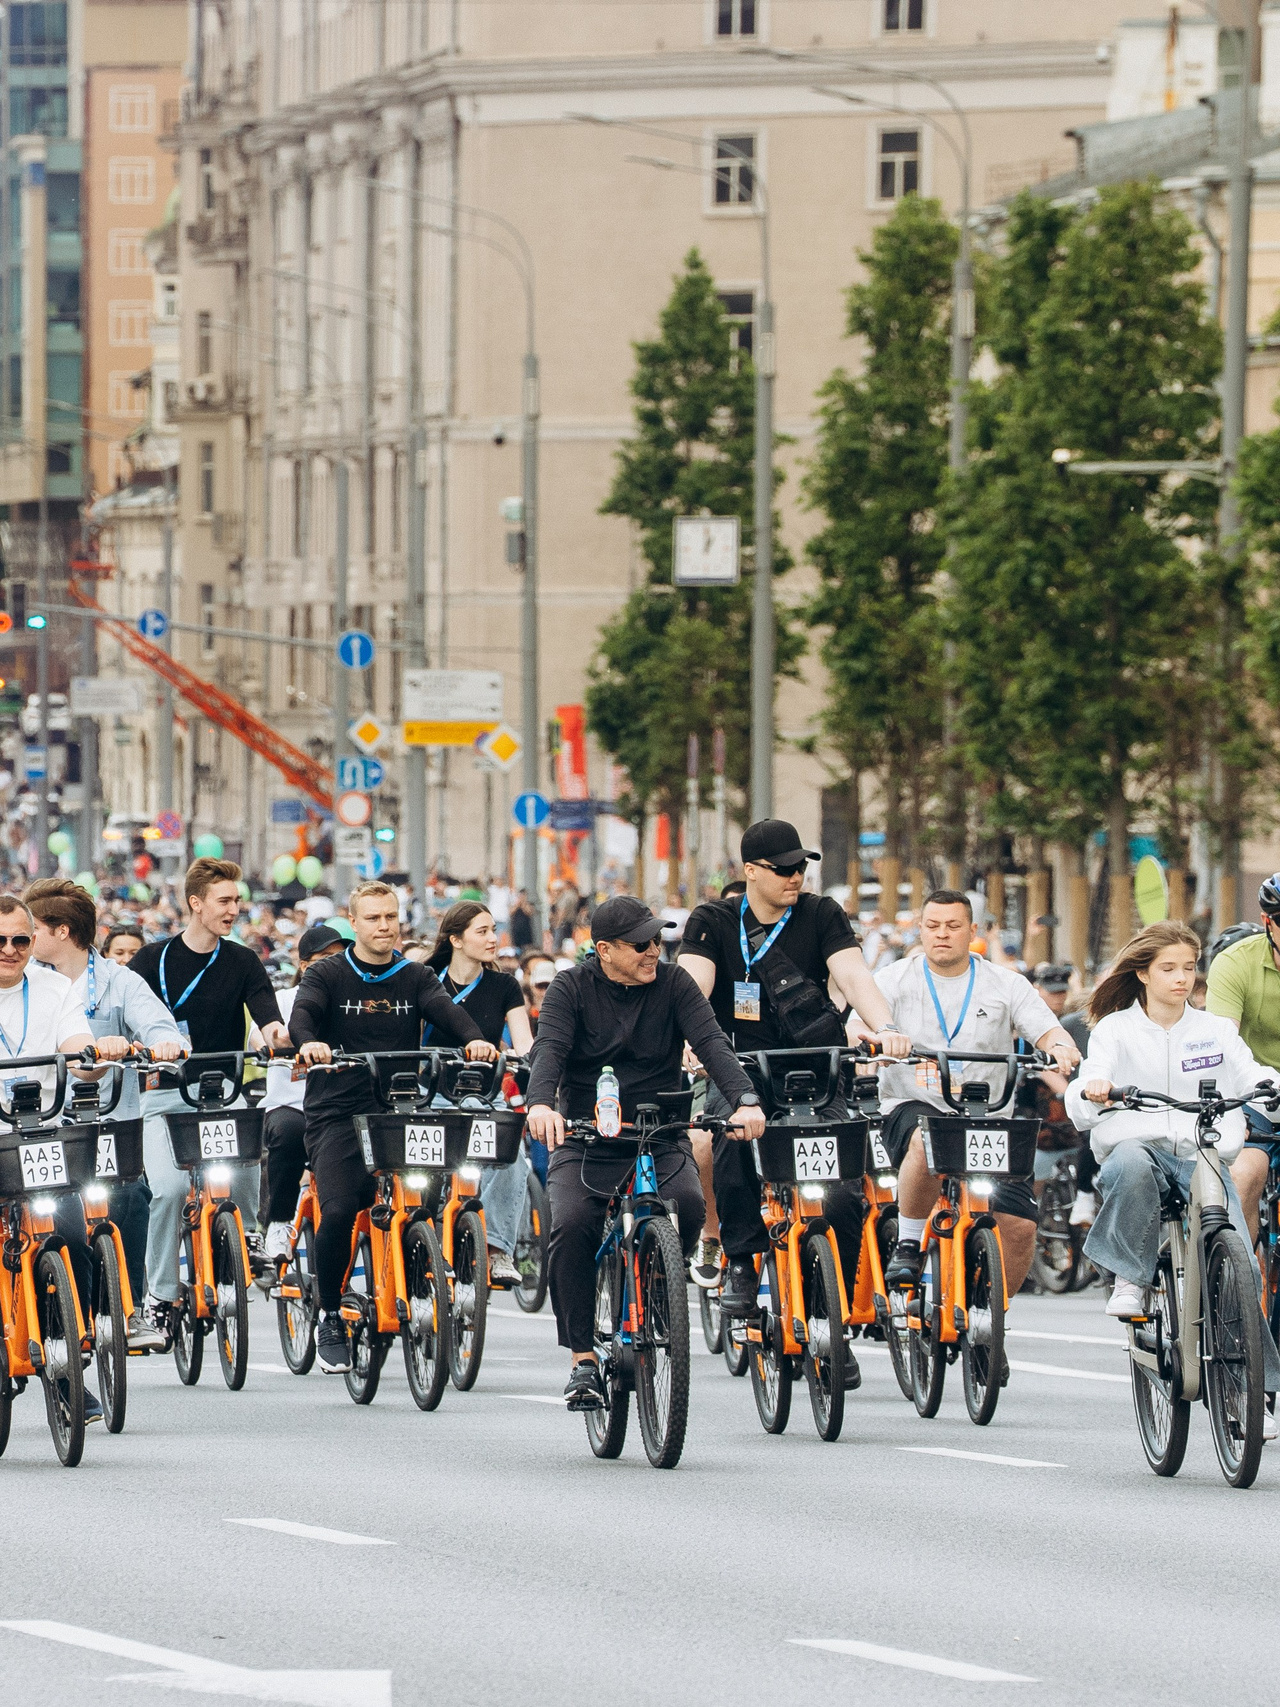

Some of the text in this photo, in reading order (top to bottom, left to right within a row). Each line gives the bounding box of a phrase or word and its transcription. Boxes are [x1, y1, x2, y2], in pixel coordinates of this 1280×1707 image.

[202, 1123, 234, 1139] АА0
[407, 1128, 443, 1144] АА0
[472, 1124, 493, 1138] А1
[203, 1139, 236, 1155] 65Т
[472, 1140, 494, 1154] 8Т
[796, 1140, 835, 1158] АА9
[968, 1134, 1005, 1149] АА4
[23, 1145, 61, 1165] АА5
[408, 1146, 443, 1162] 45Н
[26, 1164, 63, 1183] 19Р
